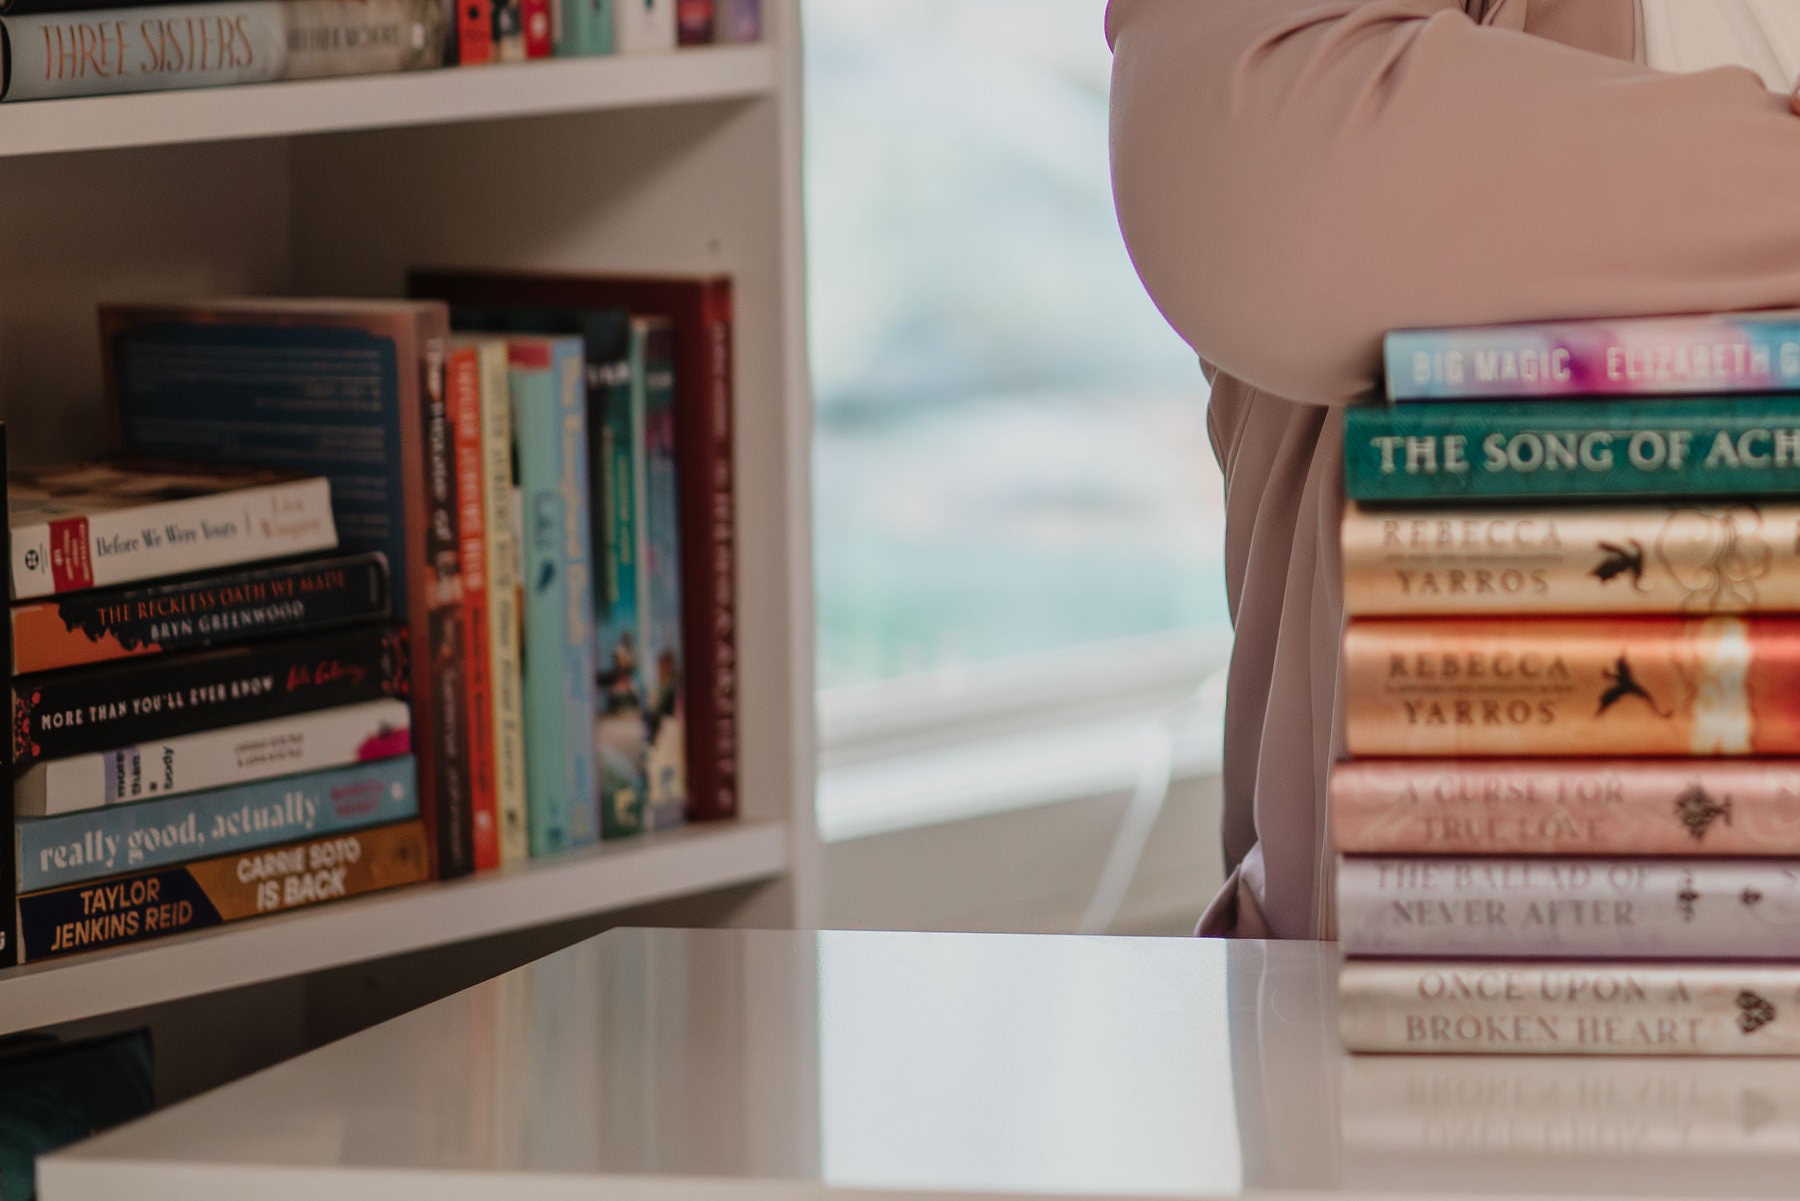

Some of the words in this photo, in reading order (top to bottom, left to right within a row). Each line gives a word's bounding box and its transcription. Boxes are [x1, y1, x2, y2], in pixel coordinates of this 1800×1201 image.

[40, 20, 135, 82] THREE
[139, 14, 255, 74] SISTERS
[1410, 350, 1465, 386] BIG
[1473, 347, 1572, 384] MAGIC
[1605, 341, 1771, 381] ELIZABETH
[1369, 434, 1471, 475] THE
[1481, 429, 1615, 474] SONG
[1627, 429, 1694, 472] OF
[96, 533, 139, 558] Before
[140, 528, 161, 548] We
[164, 524, 198, 546] Were
[200, 518, 239, 541] Yours
[1382, 519, 1563, 549] REBECCA
[98, 605, 132, 626] THE
[138, 591, 217, 620] RECKLESS
[220, 582, 268, 607] OATH
[271, 577, 294, 598] WE
[301, 569, 346, 592] MADE
[1395, 567, 1549, 595] YARROS
[150, 619, 193, 643] BRYN
[199, 599, 306, 635] GREENWOOD
[1388, 651, 1571, 680] REBECCA
[41, 704, 84, 731] MORE
[89, 700, 127, 724] THAN
[133, 690, 185, 717] YOU'LL
[190, 682, 227, 707] EVER
[230, 674, 274, 699] KNOW
[1402, 698, 1557, 725] YARROS
[1433, 776, 1537, 802] CURSE
[1556, 775, 1625, 802] FOR
[38, 830, 121, 873] really
[127, 812, 206, 865] good,
[210, 791, 321, 840] actually
[1420, 815, 1506, 841] TRUE
[1518, 814, 1602, 841] LOVE
[236, 847, 306, 885] CARRIE
[309, 836, 363, 867] SOTO
[1373, 862, 1441, 890] THE
[1455, 862, 1593, 890] BALLAD
[1607, 863, 1651, 889] OF
[79, 877, 161, 915] TAYLOR
[256, 881, 281, 912] IS
[283, 867, 347, 907] BACK
[51, 910, 140, 952] JENKINS
[145, 900, 194, 930] REID
[1391, 899, 1508, 926] NEVER
[1522, 899, 1636, 927] AFTER
[1417, 972, 1525, 1003] ONCE
[1539, 973, 1647, 1003] UPON
[1667, 976, 1692, 1004] A
[1405, 1013, 1560, 1043] BROKEN
[1576, 1014, 1705, 1046] HEART
